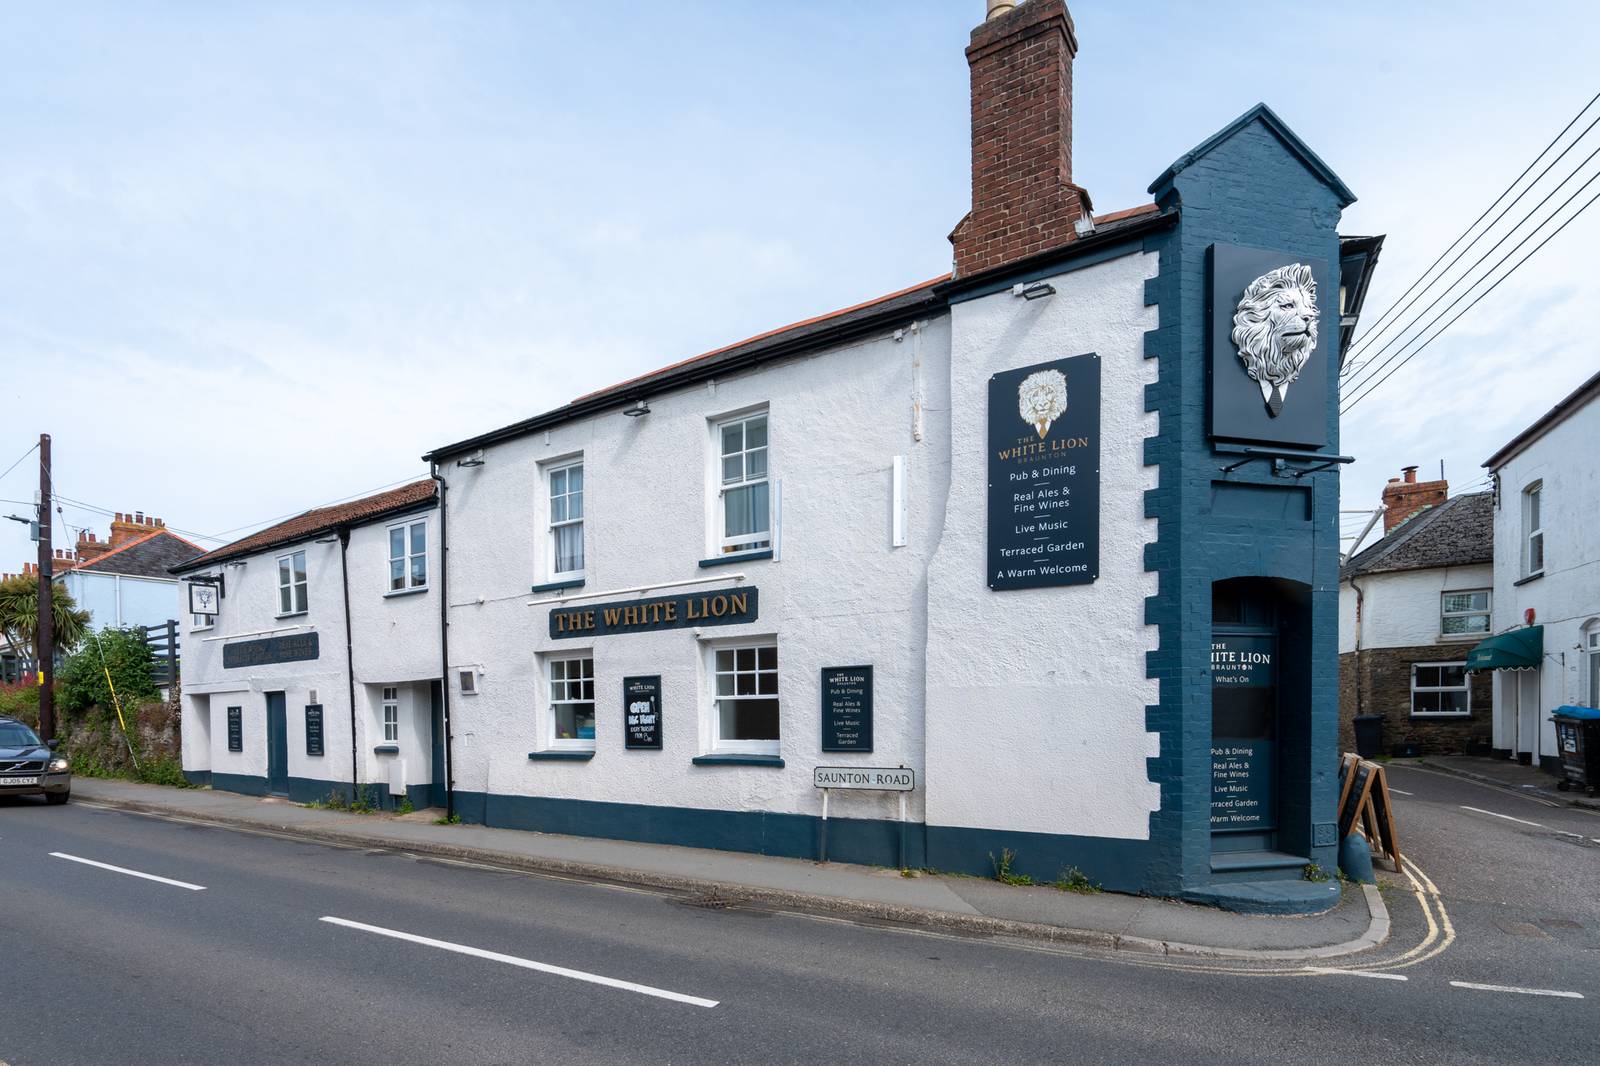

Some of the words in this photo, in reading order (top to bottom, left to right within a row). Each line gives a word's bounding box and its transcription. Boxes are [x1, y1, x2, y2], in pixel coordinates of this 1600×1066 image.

[1017, 435, 1035, 444] THE
[998, 441, 1046, 461] WHITE
[1051, 437, 1089, 451] LION
[1017, 451, 1067, 464] BRAUNTON
[1010, 471, 1029, 481] Pub
[1031, 469, 1040, 478] &
[1042, 464, 1076, 477] Dining
[1014, 491, 1034, 502] Real
[1037, 488, 1059, 499] Ales
[1062, 487, 1071, 495] &
[1014, 504, 1035, 513] Fine
[1038, 499, 1070, 510] Wines
[1015, 523, 1035, 533] Live
[1038, 520, 1069, 531] Music
[1000, 544, 1043, 557] Terraced
[1047, 541, 1085, 552] Garden
[997, 570, 1004, 579] A
[1007, 567, 1036, 578] Warm
[1039, 563, 1088, 575] Welcome
[554, 609, 595, 633] THE
[603, 601, 677, 627] WHITE
[686, 592, 748, 620] LION
[1240, 652, 1271, 664] LION
[1215, 675, 1238, 683] What's
[1239, 675, 1250, 683] On
[1231, 747, 1253, 757] Dining
[817, 772, 870, 784] SAUNTON
[876, 774, 910, 785] ROAD
[1234, 799, 1258, 807] Garden
[1230, 814, 1260, 822] Welcome
